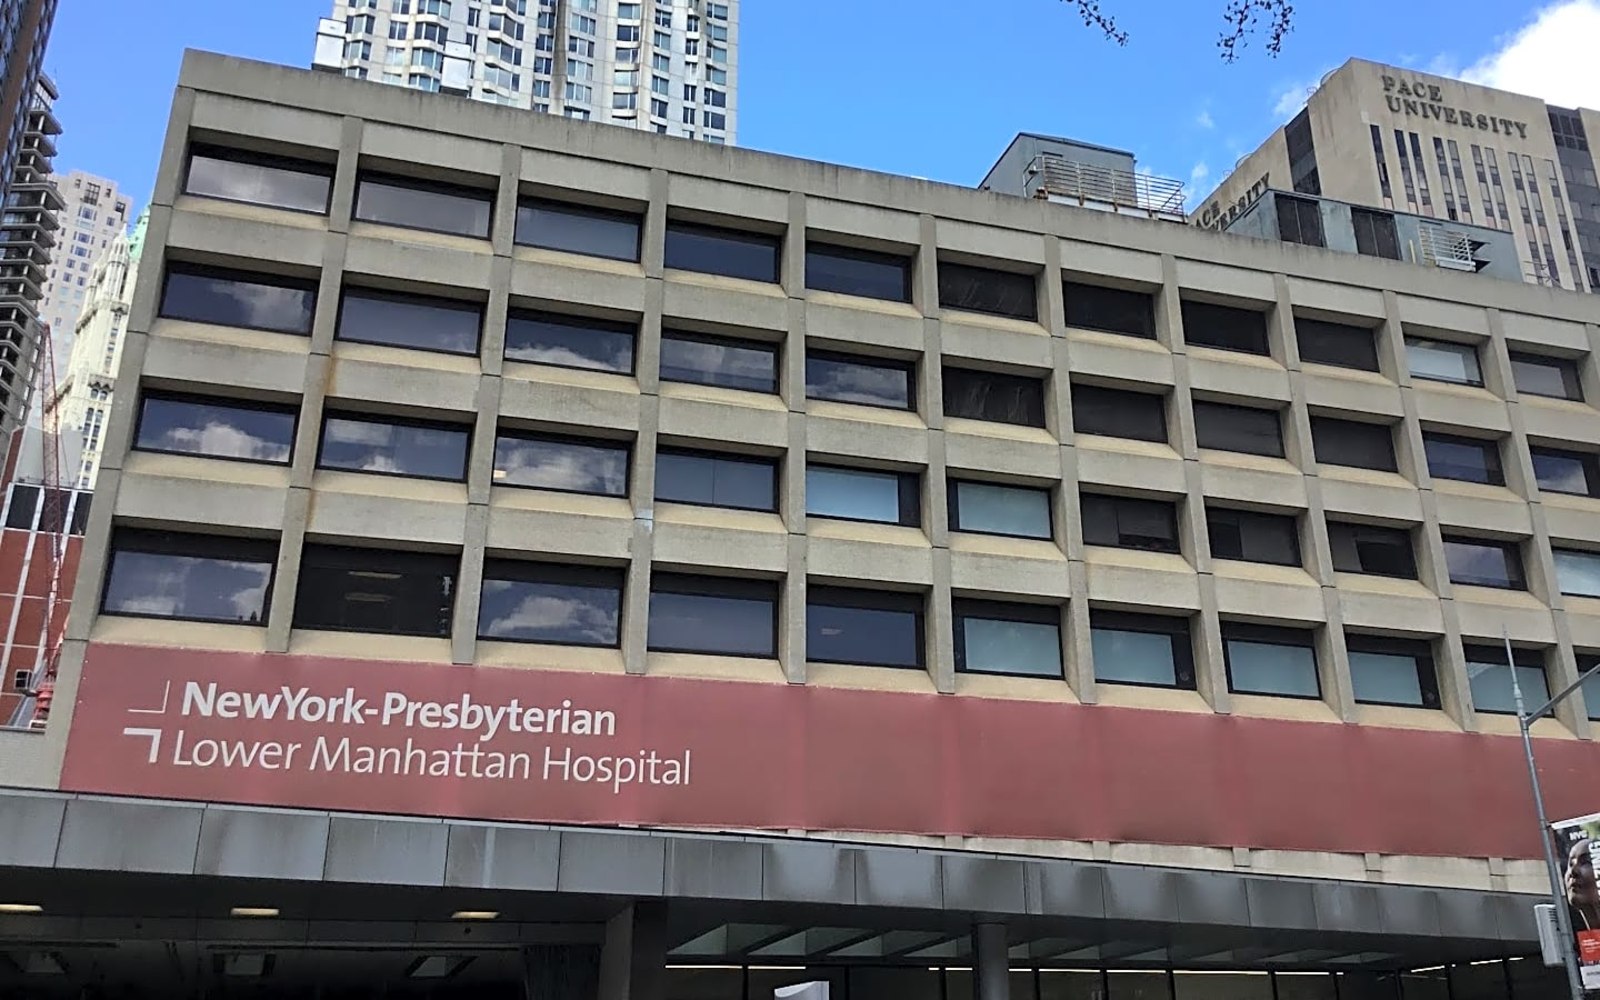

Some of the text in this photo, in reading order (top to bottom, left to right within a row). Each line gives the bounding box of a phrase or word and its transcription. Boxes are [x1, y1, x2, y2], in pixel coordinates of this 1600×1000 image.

[1381, 75, 1443, 102] PACE
[1384, 95, 1528, 138] UNIVERSITY
[181, 681, 616, 742] NewYork-Presbyterian
[172, 729, 691, 794] Lower Manhattan Hospital
